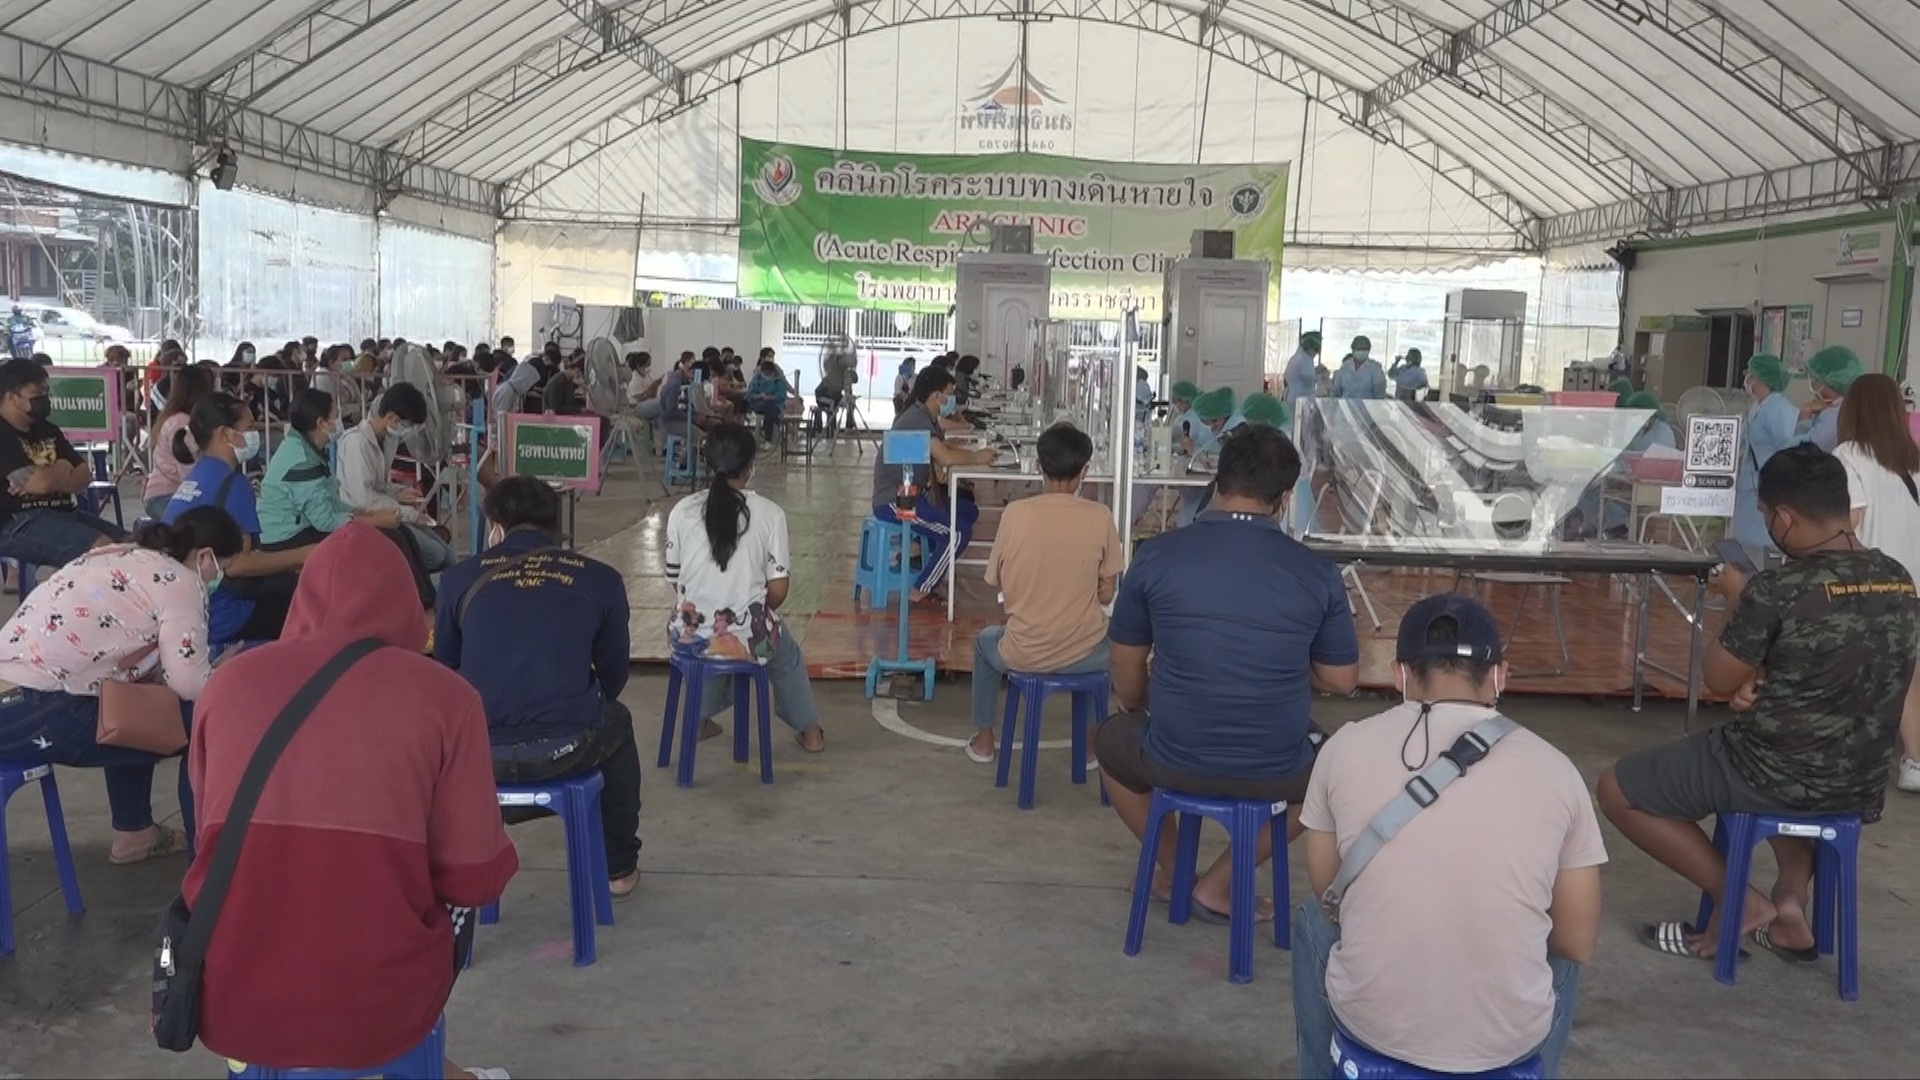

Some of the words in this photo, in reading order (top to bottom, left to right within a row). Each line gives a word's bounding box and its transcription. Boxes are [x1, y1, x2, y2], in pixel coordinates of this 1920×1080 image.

[817, 163, 1213, 207] คลินิกโรคระบบทางเดินหายใจ
[817, 234, 888, 261] (Acute
[1046, 247, 1124, 271] fection
[49, 392, 103, 412] พบแพทย์
[518, 442, 587, 461] รอพบแพทย์
